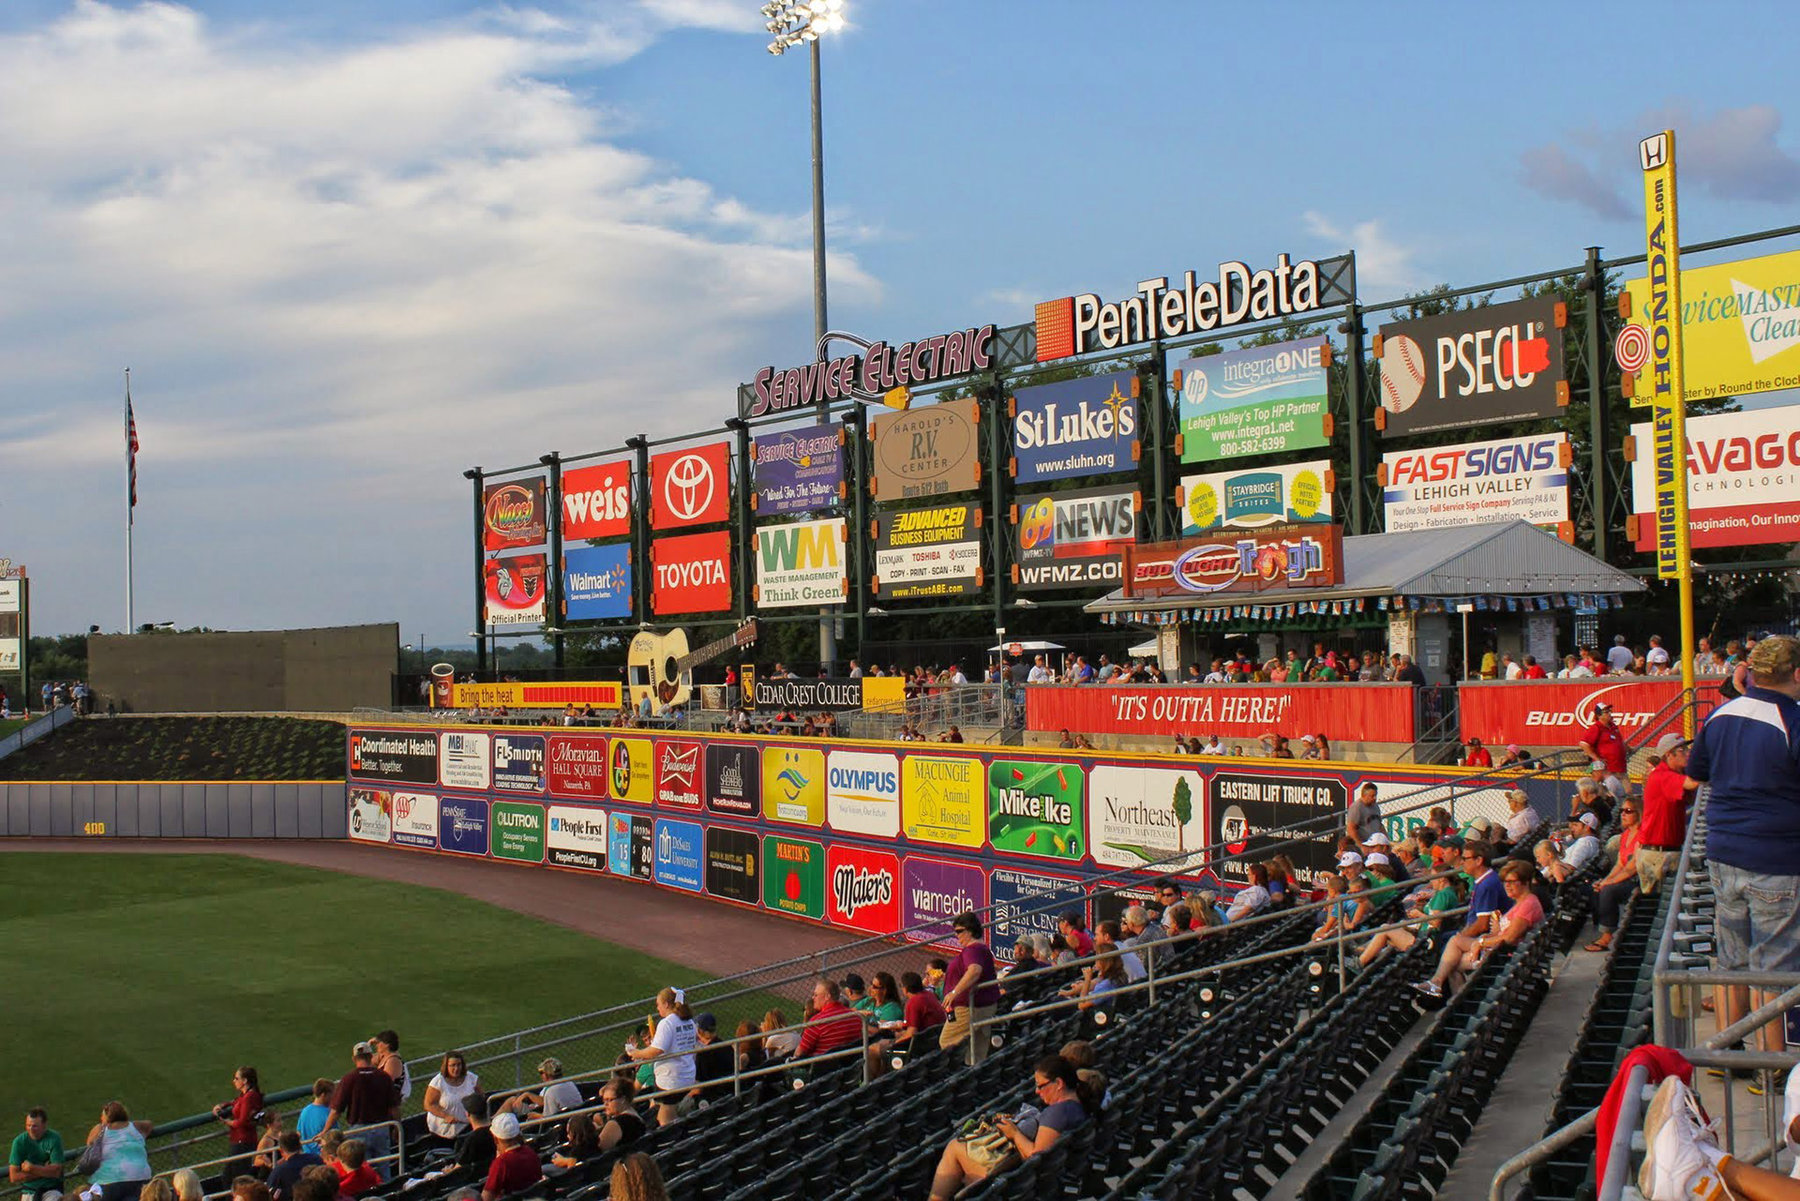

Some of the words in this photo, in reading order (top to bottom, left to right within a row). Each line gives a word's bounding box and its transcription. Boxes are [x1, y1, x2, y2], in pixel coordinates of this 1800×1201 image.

[1075, 253, 1320, 353] PenTeleData
[752, 355, 858, 417] SERVICE
[862, 324, 996, 393] ELECTRIC
[1437, 322, 1536, 399] PSECU
[1704, 386, 1716, 397] by
[1719, 380, 1752, 394] Round
[1755, 379, 1771, 390] the
[894, 415, 954, 434] HAROLD'S
[1187, 415, 1216, 431] Lehigh
[1218, 410, 1251, 428] Valley's
[1254, 408, 1270, 422] Top
[1272, 405, 1285, 418] HP
[1287, 402, 1321, 416] Partner
[1220, 436, 1286, 456] 800-582-6399
[1655, 405, 1675, 487] VALLEY
[902, 458, 948, 473] CENTER
[1036, 453, 1115, 473] www.sluhn.org
[1232, 482, 1275, 497] STAYBRIDGE
[1414, 483, 1470, 501] LEHIGH
[1475, 477, 1533, 495] VALLEY
[564, 476, 628, 525] weis
[1239, 499, 1269, 508] SUITES
[1393, 507, 1405, 516] Your
[1405, 506, 1416, 515] One
[1416, 504, 1429, 515] Stop
[1429, 503, 1442, 514] Full
[1442, 501, 1465, 512] Service
[1465, 500, 1480, 511] Sign
[1480, 499, 1511, 510] Company
[1534, 494, 1544, 504] PA
[894, 506, 967, 532] ADVANCED
[1056, 498, 1133, 540] NEWS
[1393, 521, 1419, 532] Design
[1426, 516, 1468, 527] Fabrication
[1475, 511, 1521, 523] Installation
[1529, 508, 1559, 519] Service
[1689, 516, 1749, 532] magination,
[1751, 514, 1771, 525] Our
[890, 530, 923, 546] BUSINESS
[923, 527, 965, 543] EQUIPMENT
[1658, 490, 1678, 574] LEHIGH
[912, 551, 941, 562] TOSHIBA
[657, 558, 726, 589] TOYOTA
[890, 569, 905, 578] COPY
[910, 567, 927, 577] PRINT
[931, 566, 948, 575] SCAN
[953, 564, 965, 573] FAX
[1134, 562, 1174, 580] BUD
[1180, 554, 1240, 575] LIGHT
[569, 570, 611, 591] Walmart
[763, 575, 787, 584] WASTE
[788, 571, 838, 582] MANAGEMENT
[764, 587, 799, 602] Think
[491, 613, 517, 624] Official
[517, 613, 542, 623] Printer
[460, 686, 480, 704] Bring
[481, 688, 493, 702] the
[495, 687, 514, 703] heat
[755, 682, 787, 706] CEDAR
[785, 682, 815, 705] CREST
[816, 681, 860, 706] COLLEGE
[1152, 696, 1214, 723] OUTTA
[1218, 695, 1291, 723] HERE!"
[1526, 711, 1575, 726] BUD
[1586, 711, 1655, 726] LGHT
[361, 736, 408, 755] Coordinated
[409, 739, 436, 756] Health
[551, 742, 604, 762] Moravian
[361, 758, 379, 770] Better.
[553, 763, 572, 775] HALL
[573, 763, 603, 778] SQUARE
[914, 762, 970, 783] MACUNGIE
[829, 767, 896, 793] OLYMPUS
[942, 787, 970, 804] Animal
[1220, 781, 1261, 801] EASTERN
[1262, 784, 1281, 803] LIFT
[1282, 785, 1315, 804] TRUCK
[1316, 787, 1334, 806] CO.
[1000, 787, 1040, 818] Mike
[1045, 795, 1072, 825] Ike
[1104, 796, 1177, 828] Northeast
[502, 812, 539, 829] LUTRON
[560, 817, 584, 837] People
[585, 820, 602, 836] First
[940, 807, 971, 827] Hospital
[83, 822, 105, 835] 400
[1103, 824, 1131, 835] PROPERTY
[1134, 827, 1177, 839] MAINTENANCE
[619, 843, 628, 860] 15
[641, 846, 652, 863] 80
[776, 842, 810, 863] MARTIN'S
[834, 865, 892, 918] Maier's
[1016, 884, 1025, 895] for
[912, 888, 974, 916] viamedia
[1031, 911, 1062, 932] CENT
